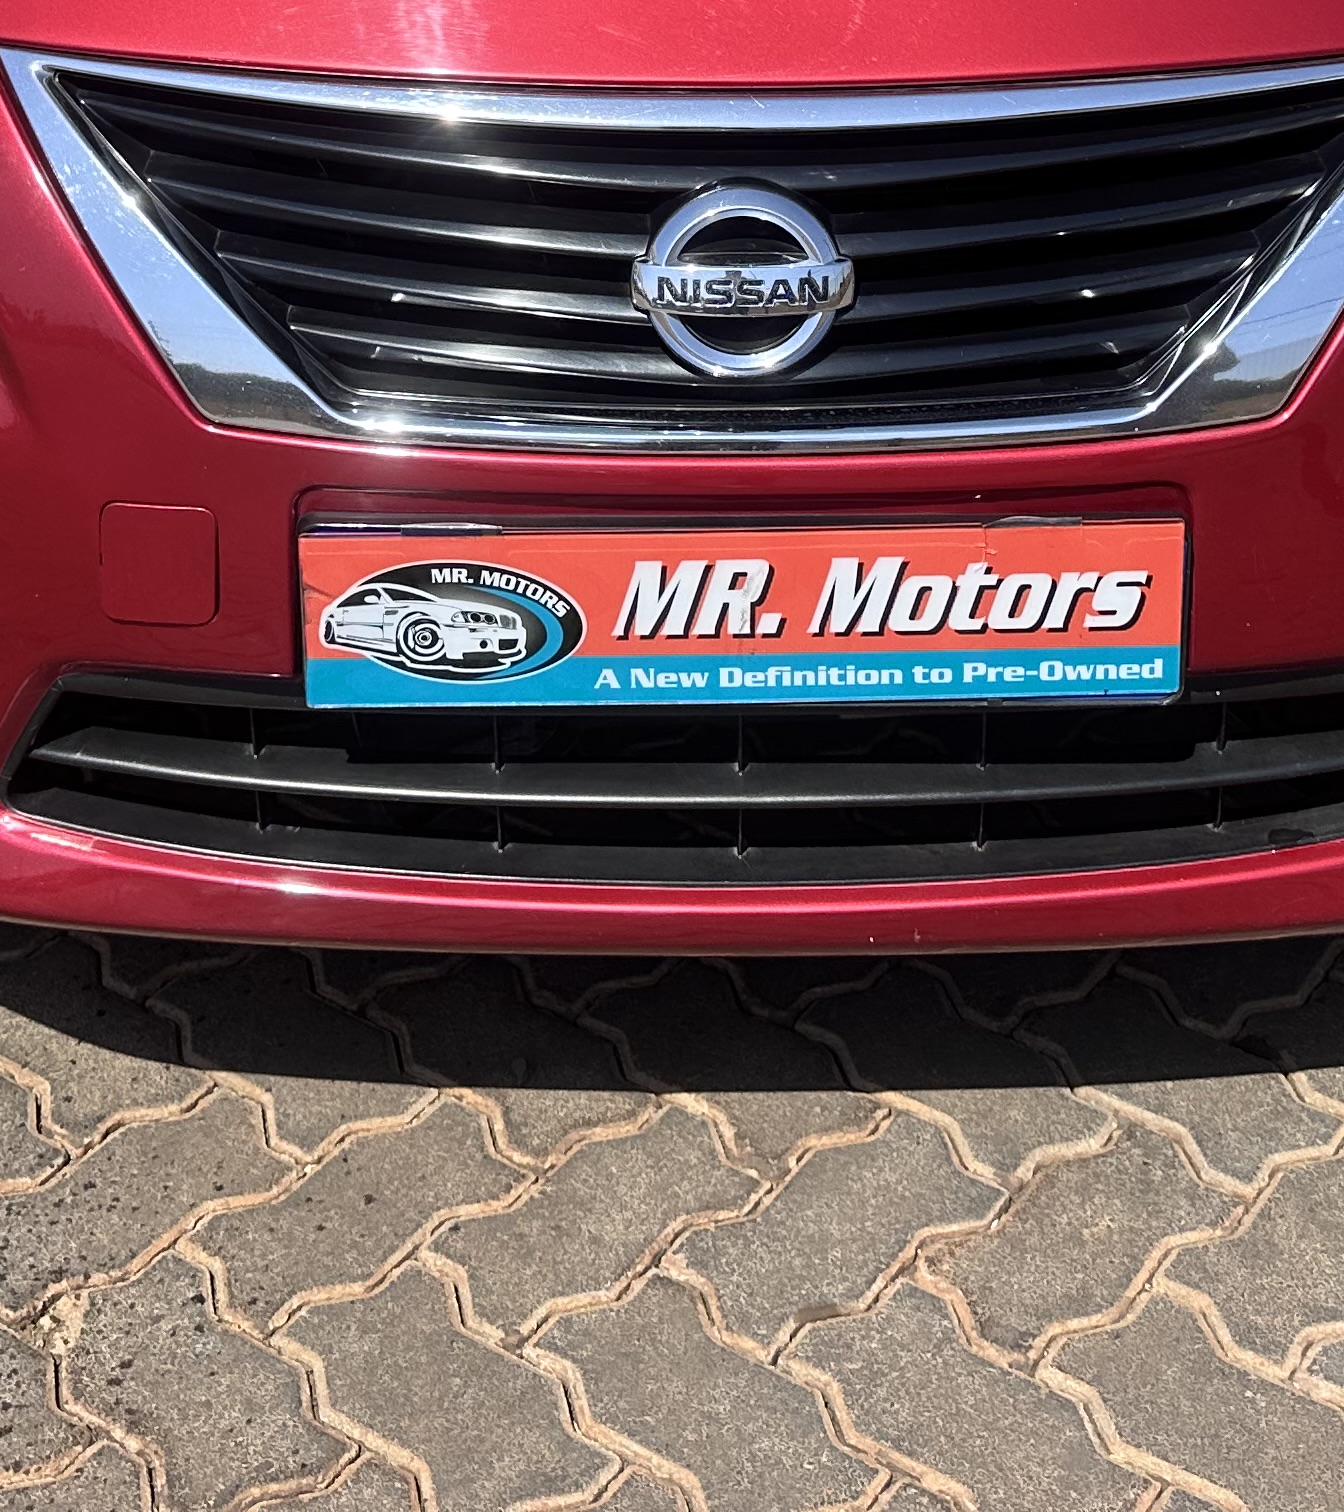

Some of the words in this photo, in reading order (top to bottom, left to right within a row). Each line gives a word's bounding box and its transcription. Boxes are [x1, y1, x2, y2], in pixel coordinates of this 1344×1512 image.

[656, 275, 830, 308] NISSAN
[430, 567, 474, 584] MR.
[480, 569, 571, 619] MOTORS
[610, 558, 788, 641] MR.
[805, 555, 1153, 638] Motors
[593, 667, 622, 689] A
[630, 667, 709, 689] New
[719, 664, 904, 688] Definition
[912, 664, 953, 685] to
[962, 658, 1164, 684] Pre-Owned
